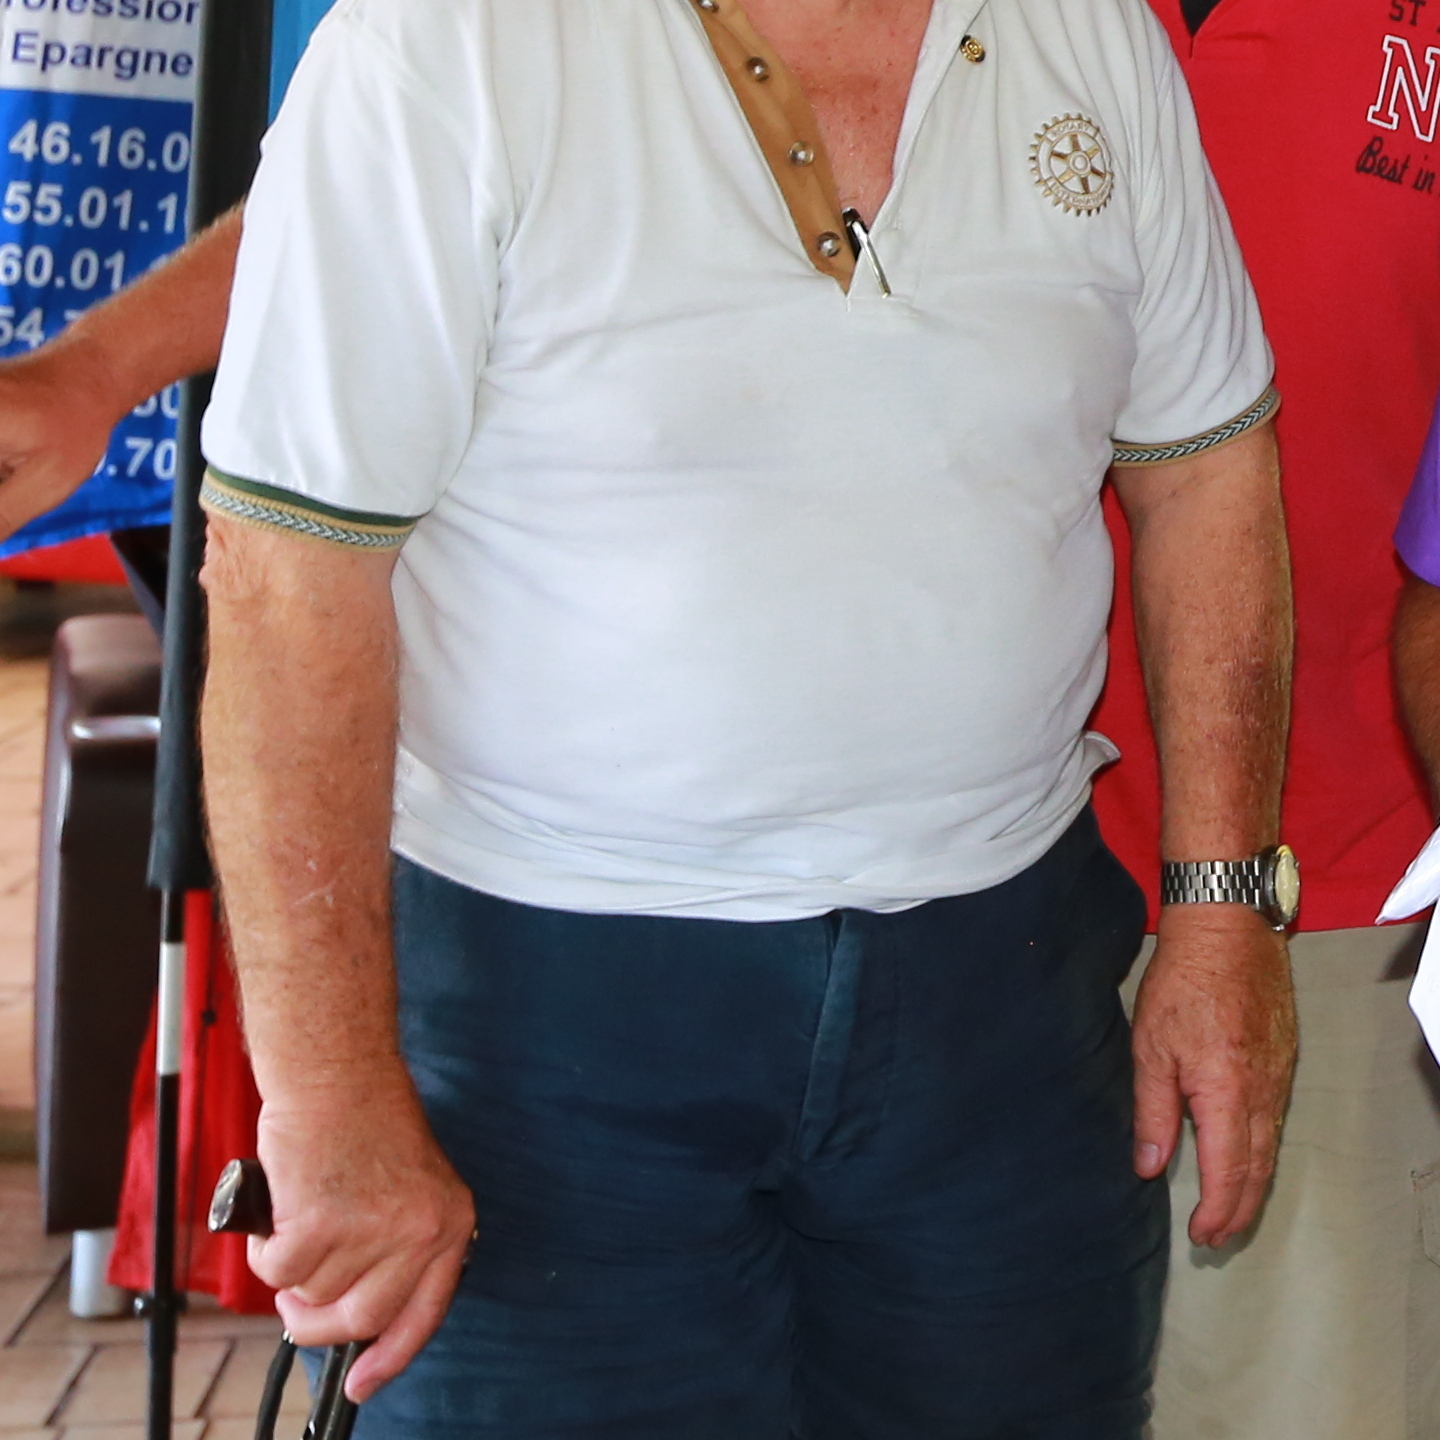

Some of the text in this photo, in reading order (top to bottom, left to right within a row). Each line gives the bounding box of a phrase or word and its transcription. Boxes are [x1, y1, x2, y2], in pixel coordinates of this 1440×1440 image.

[12, 31, 193, 80] Epargne
[8, 119, 190, 173] 46.16.0
[1356, 136, 1411, 185] Best
[1411, 155, 1435, 195] in
[0, 243, 168, 292] 60.01
[93, 436, 177, 481] .70
